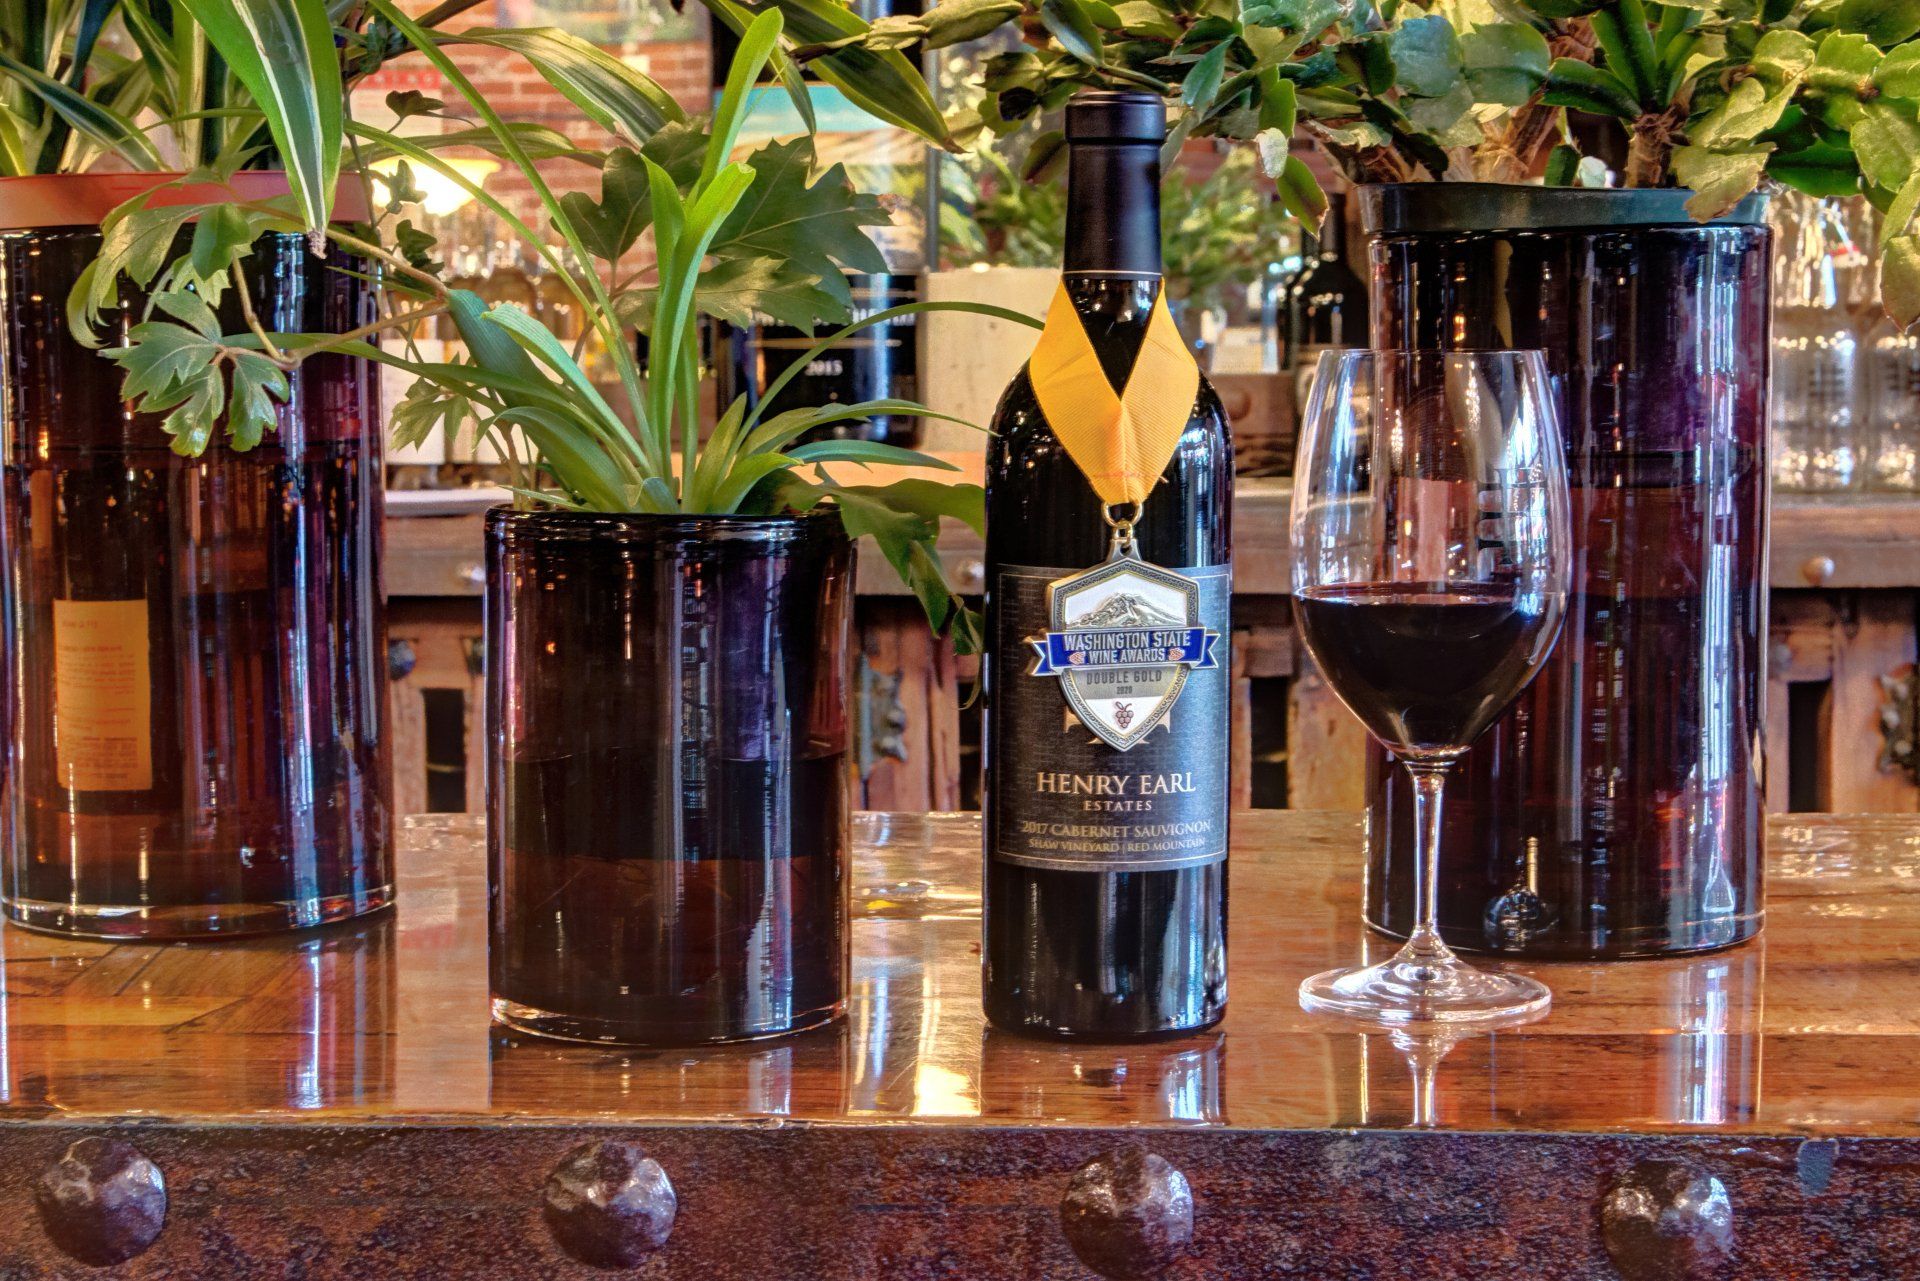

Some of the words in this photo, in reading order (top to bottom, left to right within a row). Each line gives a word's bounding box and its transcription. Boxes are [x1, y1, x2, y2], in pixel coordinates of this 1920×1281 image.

[1064, 632, 1149, 651] WASHINGTON
[1153, 630, 1191, 647] STATE
[1088, 650, 1118, 664] WINE
[1120, 648, 1166, 662] AWARDS
[1086, 671, 1129, 685] DOUBLE
[1133, 670, 1162, 683] GOLD
[1036, 772, 1130, 795] HENRY
[1140, 772, 1197, 795] EARL
[1083, 800, 1153, 812] ESTATES
[1021, 821, 1048, 834] 2017
[1051, 824, 1134, 838] CABERNET
[1134, 819, 1211, 838] SAUVIGNON
[1028, 838, 1060, 849] SHAW
[1061, 841, 1120, 852] VINEYARD
[1128, 842, 1150, 852] RED
[1153, 837, 1206, 851] MOUNTAIN
